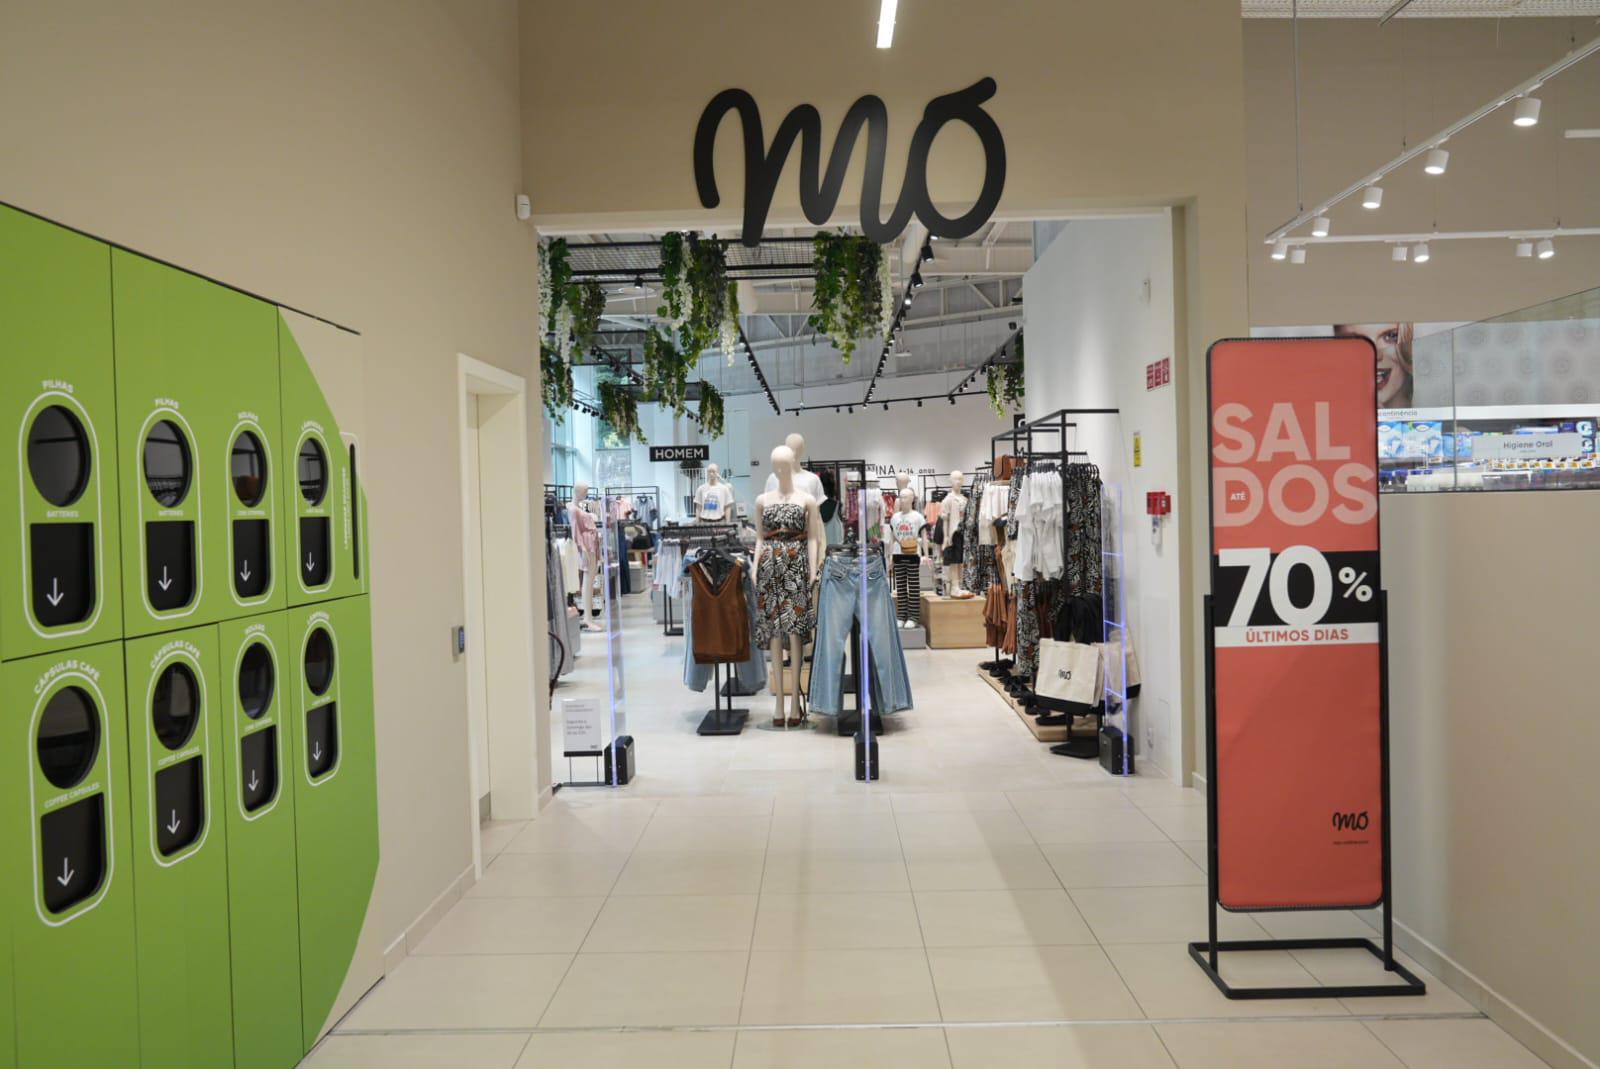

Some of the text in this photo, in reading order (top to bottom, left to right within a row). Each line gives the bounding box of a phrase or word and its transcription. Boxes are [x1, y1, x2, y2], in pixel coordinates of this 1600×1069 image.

[1212, 401, 1351, 464] SAL
[1503, 440, 1553, 450] Higiene Oral
[655, 447, 704, 460] HOMEM
[1212, 462, 1379, 527] DOS
[1230, 491, 1247, 501] ATÉ
[1245, 627, 1349, 643] ÚLTIMOS DIAS
